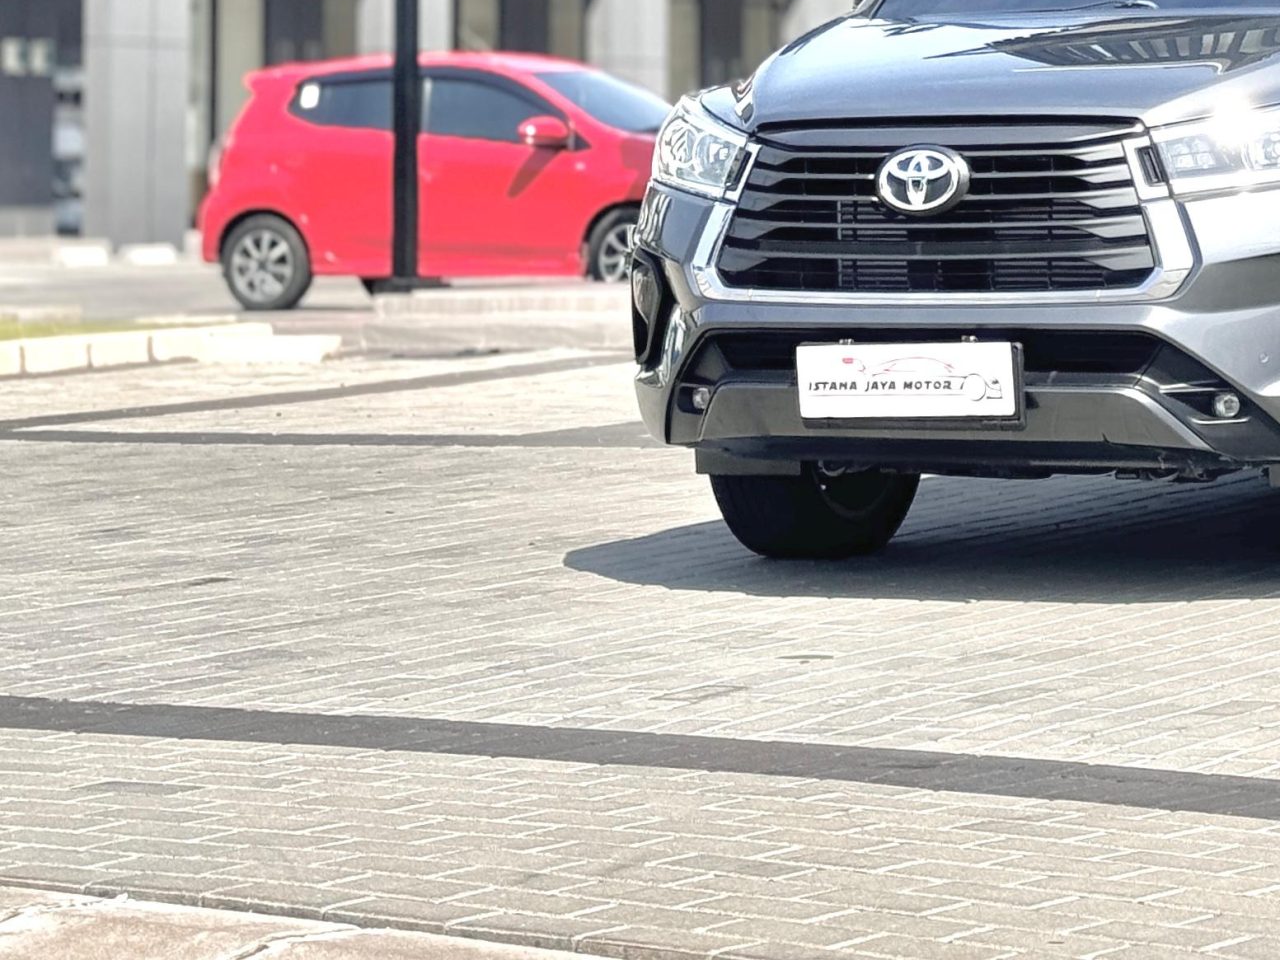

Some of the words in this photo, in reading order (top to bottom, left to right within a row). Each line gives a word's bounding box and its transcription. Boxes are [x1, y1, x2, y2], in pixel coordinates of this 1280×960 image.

[808, 381, 858, 392] ISTANA
[865, 380, 897, 392] JAYA
[903, 380, 953, 391] MOTOR
